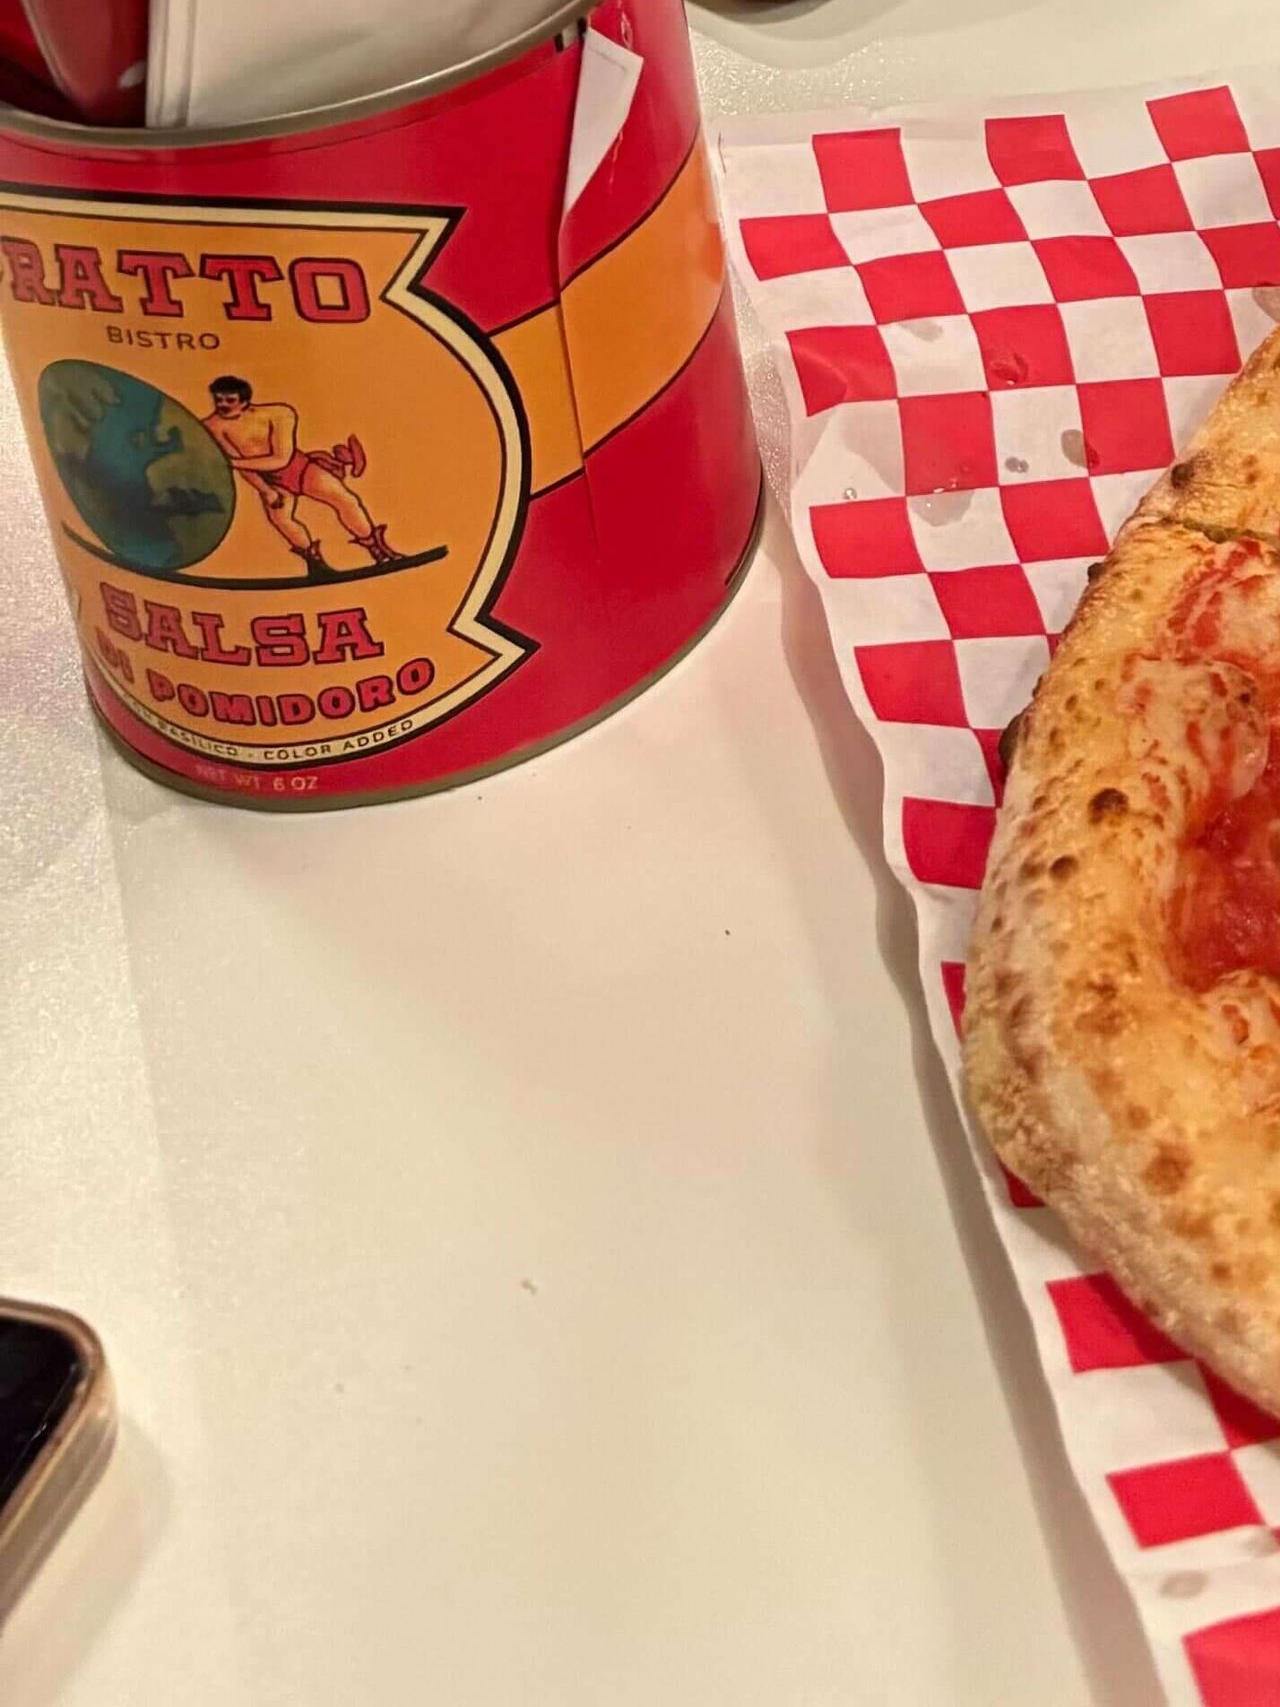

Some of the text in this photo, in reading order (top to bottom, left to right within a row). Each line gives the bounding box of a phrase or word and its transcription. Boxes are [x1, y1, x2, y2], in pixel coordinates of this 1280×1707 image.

[0, 235, 372, 323] RATTO
[106, 325, 221, 351] BISTRO
[100, 581, 385, 667] SALSA
[146, 657, 436, 727] POMIDORO
[263, 744, 331, 761] COLOR
[342, 718, 414, 751] ADDED
[272, 775, 286, 792] 6
[290, 775, 319, 791] OZ
